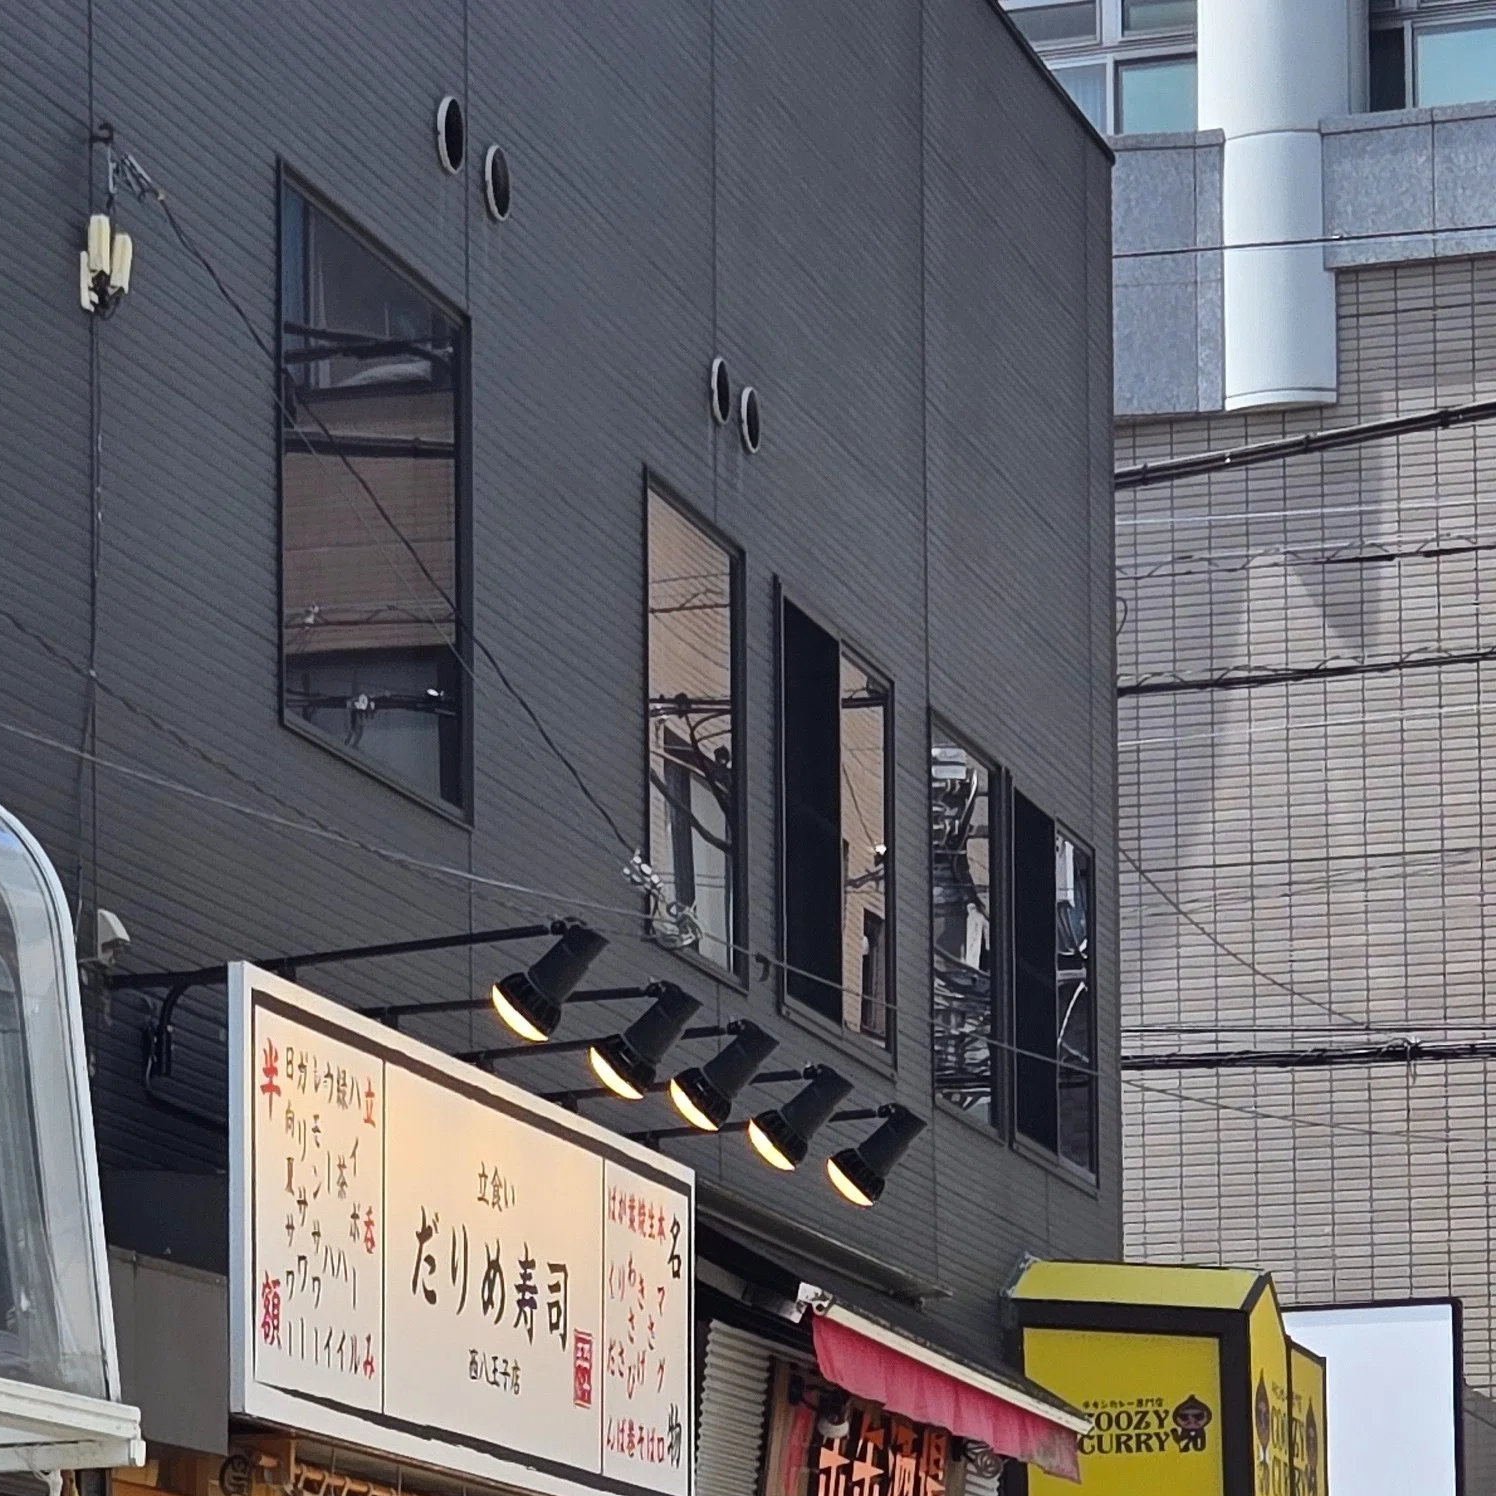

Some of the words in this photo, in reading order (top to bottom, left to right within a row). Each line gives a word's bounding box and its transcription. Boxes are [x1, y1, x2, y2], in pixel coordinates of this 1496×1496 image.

[260, 1037, 282, 1350] 半額
[310, 1054, 322, 1366] レモンサワー
[335, 1066, 349, 1372] 緑茶ハイ
[349, 1075, 362, 1375] ハイボール
[412, 1205, 569, 1352] だりめ寿司
[477, 1161, 516, 1212] 立食い
[469, 1349, 522, 1395] 西八王子店
[667, 1213, 682, 1469] 名物
[1078, 1431, 1170, 1455] CURRY
